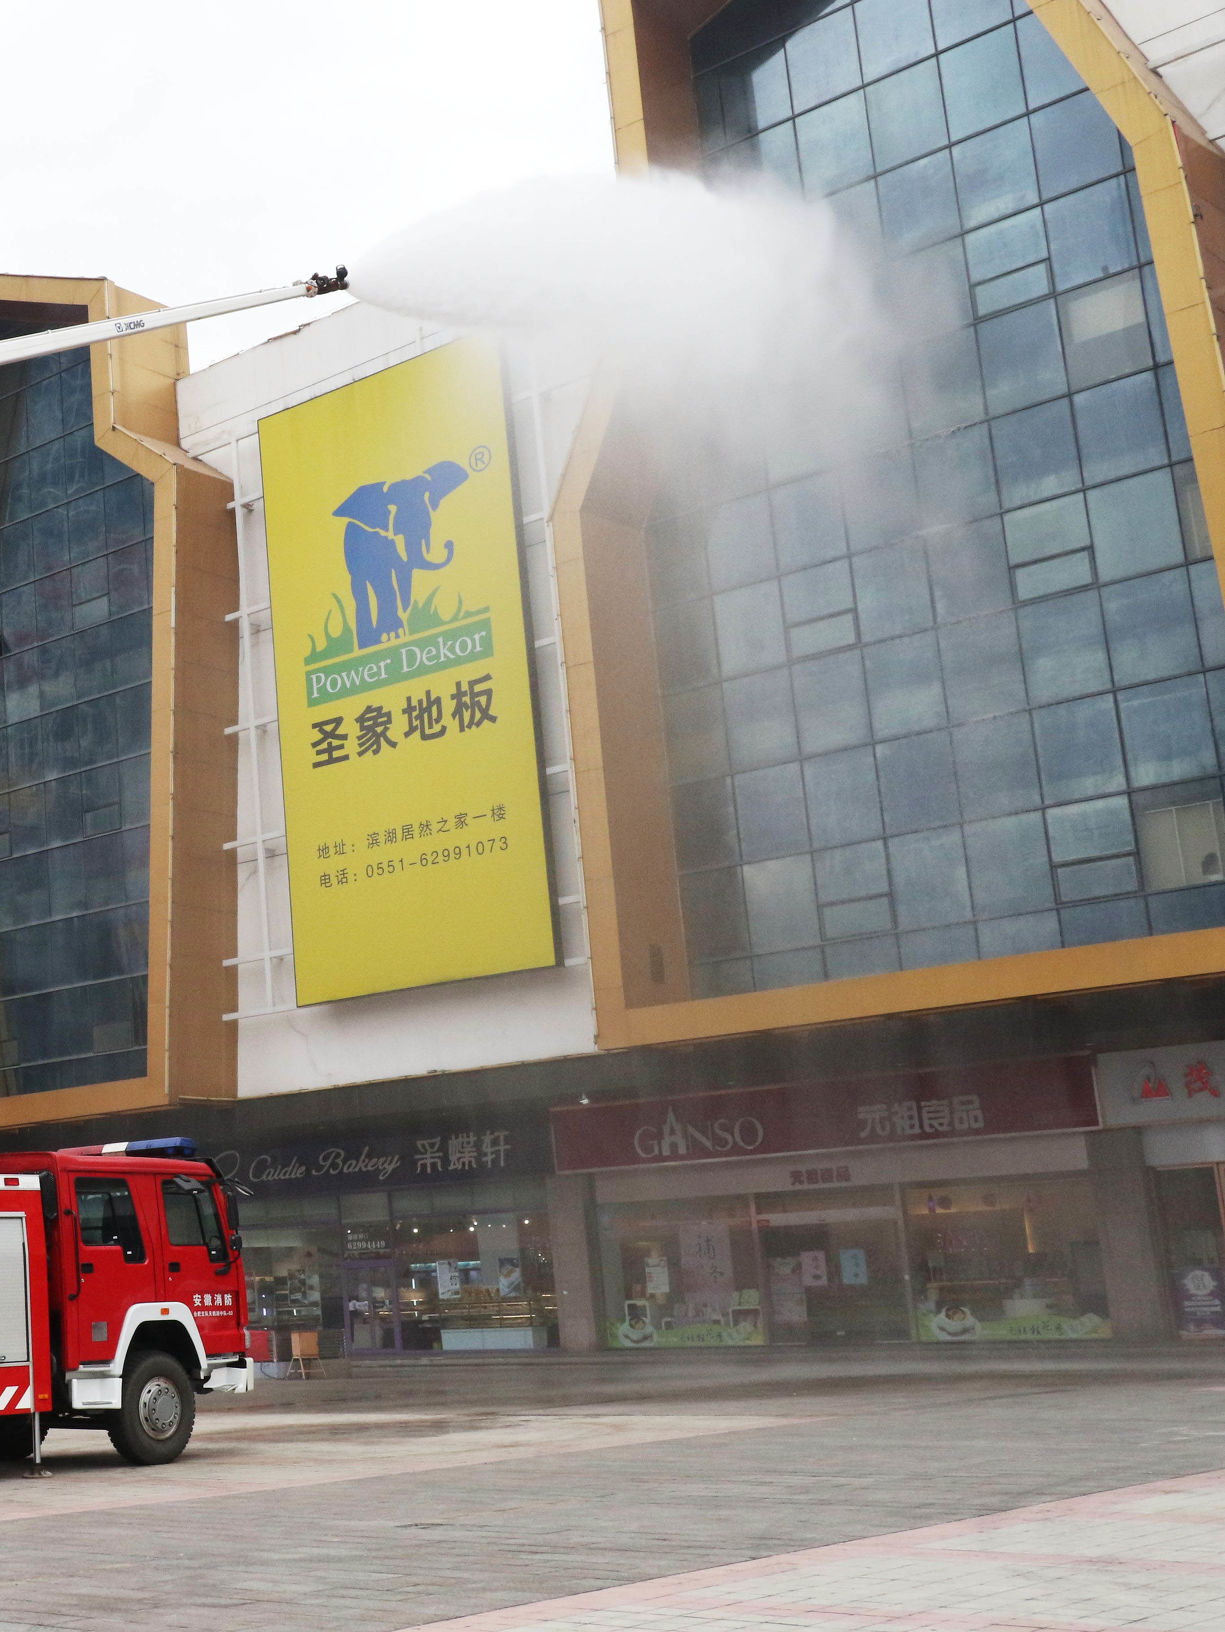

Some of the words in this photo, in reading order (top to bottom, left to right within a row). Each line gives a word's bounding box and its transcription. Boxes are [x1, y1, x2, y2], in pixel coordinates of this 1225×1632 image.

[310, 656, 392, 700] Power
[400, 628, 487, 676] Dekor
[311, 674, 498, 769] 圣象地板
[634, 1105, 764, 1157] GANSO
[858, 1096, 984, 1138] 元祖食品
[311, 1146, 401, 1180] Bakery
[414, 1130, 511, 1174] 采蝶轩
[192, 1293, 233, 1306] 安徽消防
